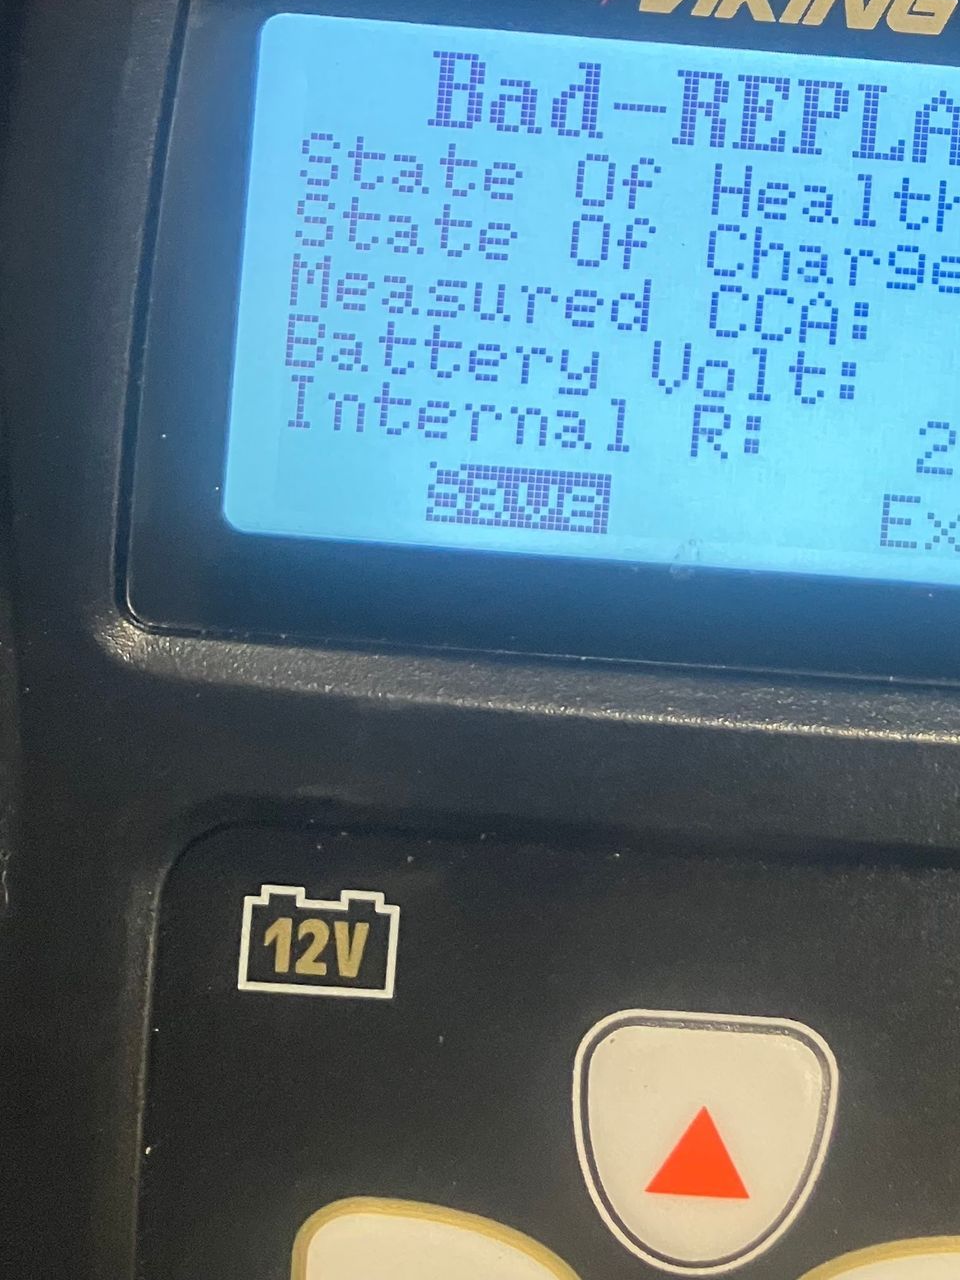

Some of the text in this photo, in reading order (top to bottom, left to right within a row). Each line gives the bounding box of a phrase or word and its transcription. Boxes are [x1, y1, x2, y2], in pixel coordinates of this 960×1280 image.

[299, 132, 524, 201] State
[576, 153, 661, 209] Of
[294, 193, 518, 261] State
[570, 213, 656, 269] Of
[290, 253, 652, 332] Measured
[709, 284, 869, 345] CCA:
[285, 313, 600, 396] Battery
[651, 340, 856, 404] Volt:
[288, 374, 630, 453] Internal
[690, 404, 761, 459] R:
[263, 916, 370, 978] 12V
